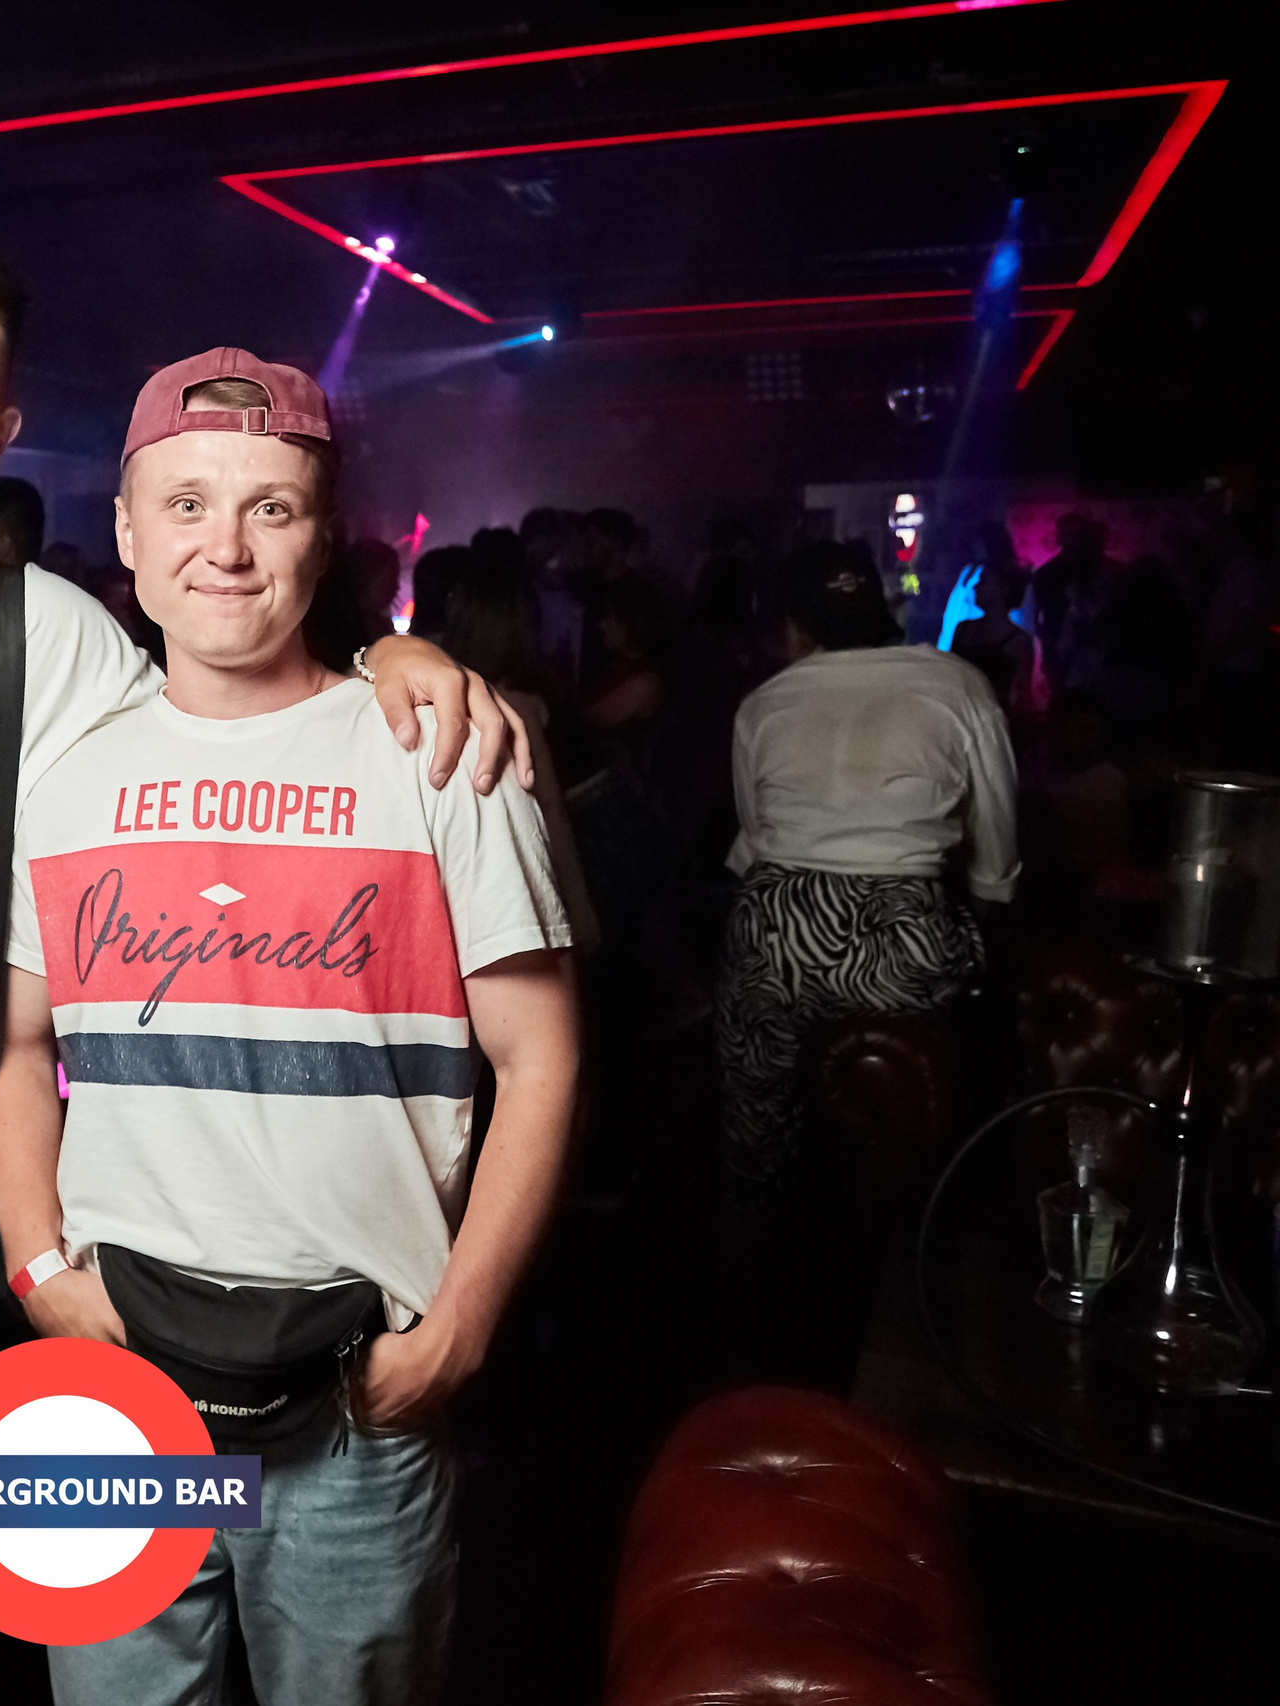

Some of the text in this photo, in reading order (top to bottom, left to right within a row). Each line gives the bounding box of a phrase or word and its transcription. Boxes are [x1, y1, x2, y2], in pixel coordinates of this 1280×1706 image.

[113, 778, 358, 837] LEE COOPER
[75, 867, 380, 1028] Originals
